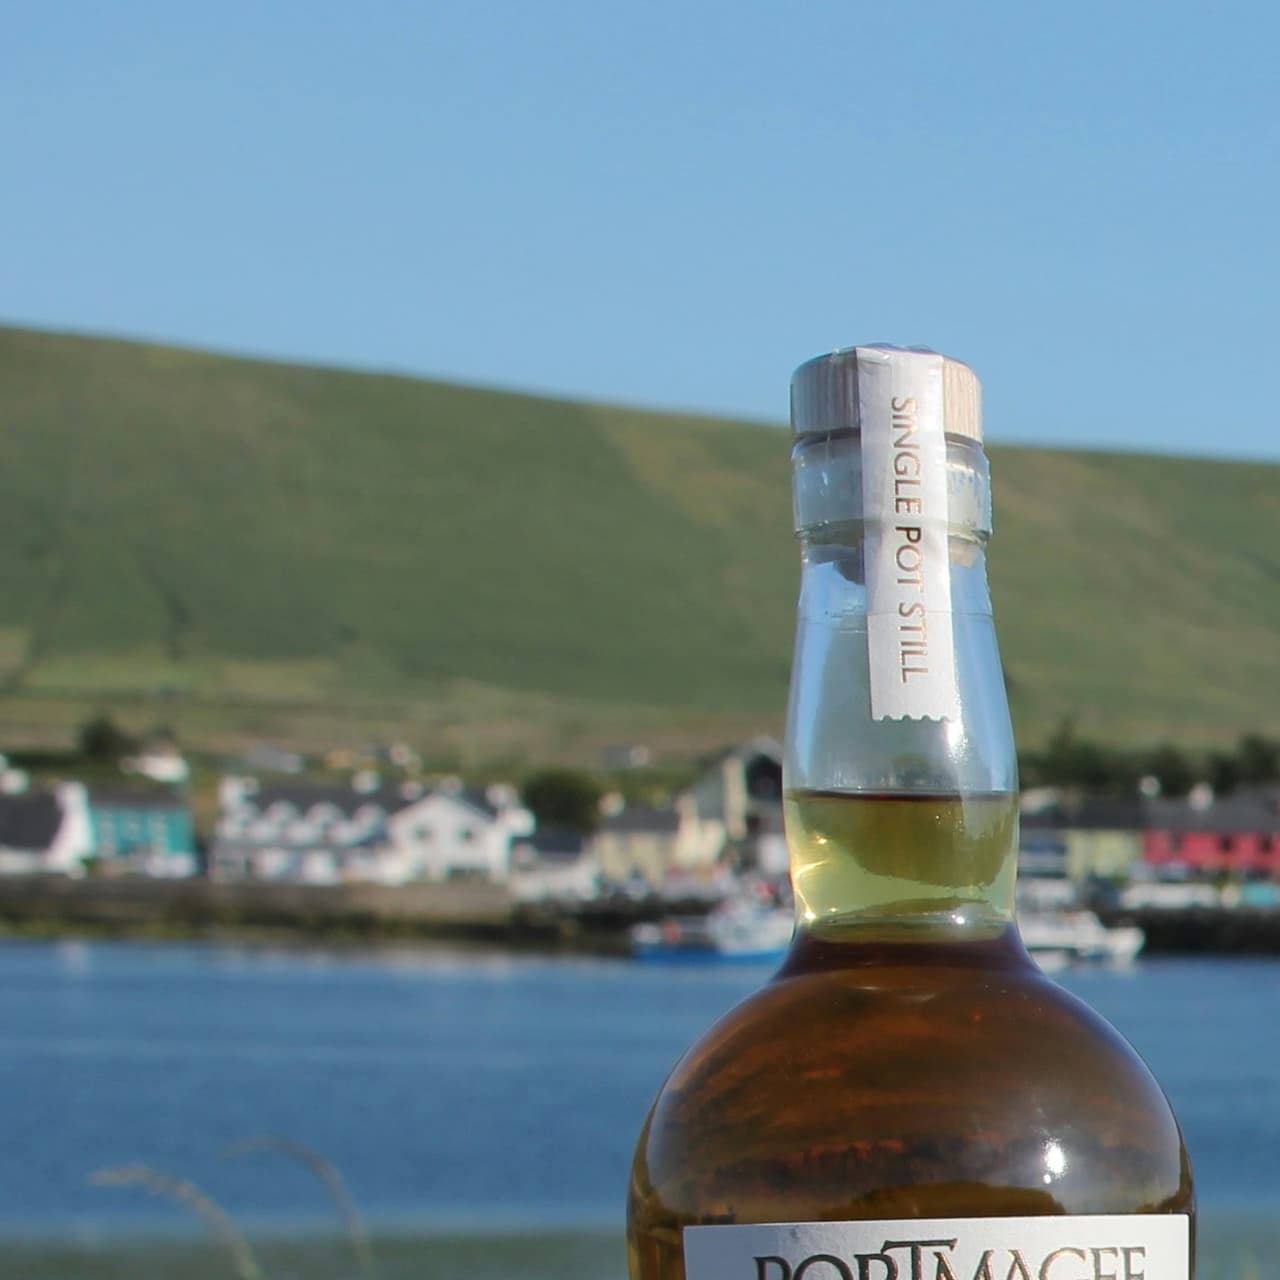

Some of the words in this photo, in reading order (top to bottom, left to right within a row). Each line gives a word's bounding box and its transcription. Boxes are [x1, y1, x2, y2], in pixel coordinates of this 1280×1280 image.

[890, 396, 922, 515] SINGLE
[895, 525, 927, 592] POT
[899, 602, 929, 684] STILL
